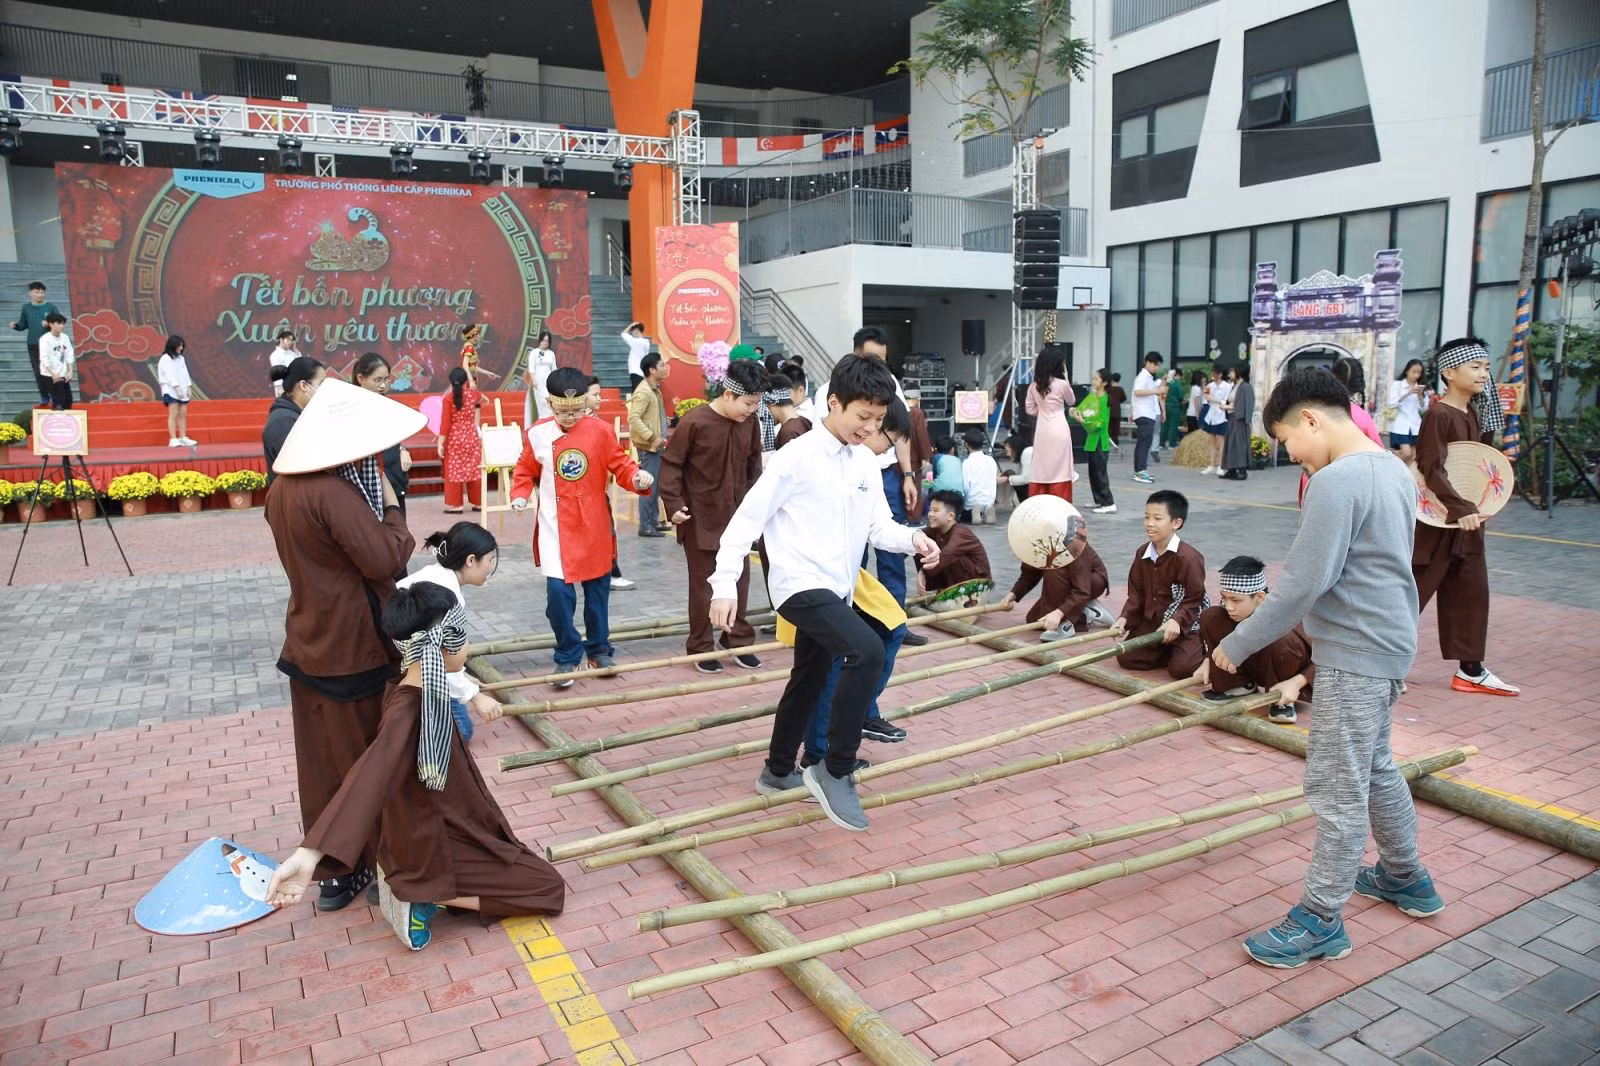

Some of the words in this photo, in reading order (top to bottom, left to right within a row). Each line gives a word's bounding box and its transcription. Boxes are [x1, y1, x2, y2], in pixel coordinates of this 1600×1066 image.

[183, 175, 241, 184] PHENIKAA
[381, 183, 402, 193] LIÊN
[425, 186, 472, 196] PHENIKAA
[359, 276, 475, 316] phương
[324, 316, 380, 352] yêu
